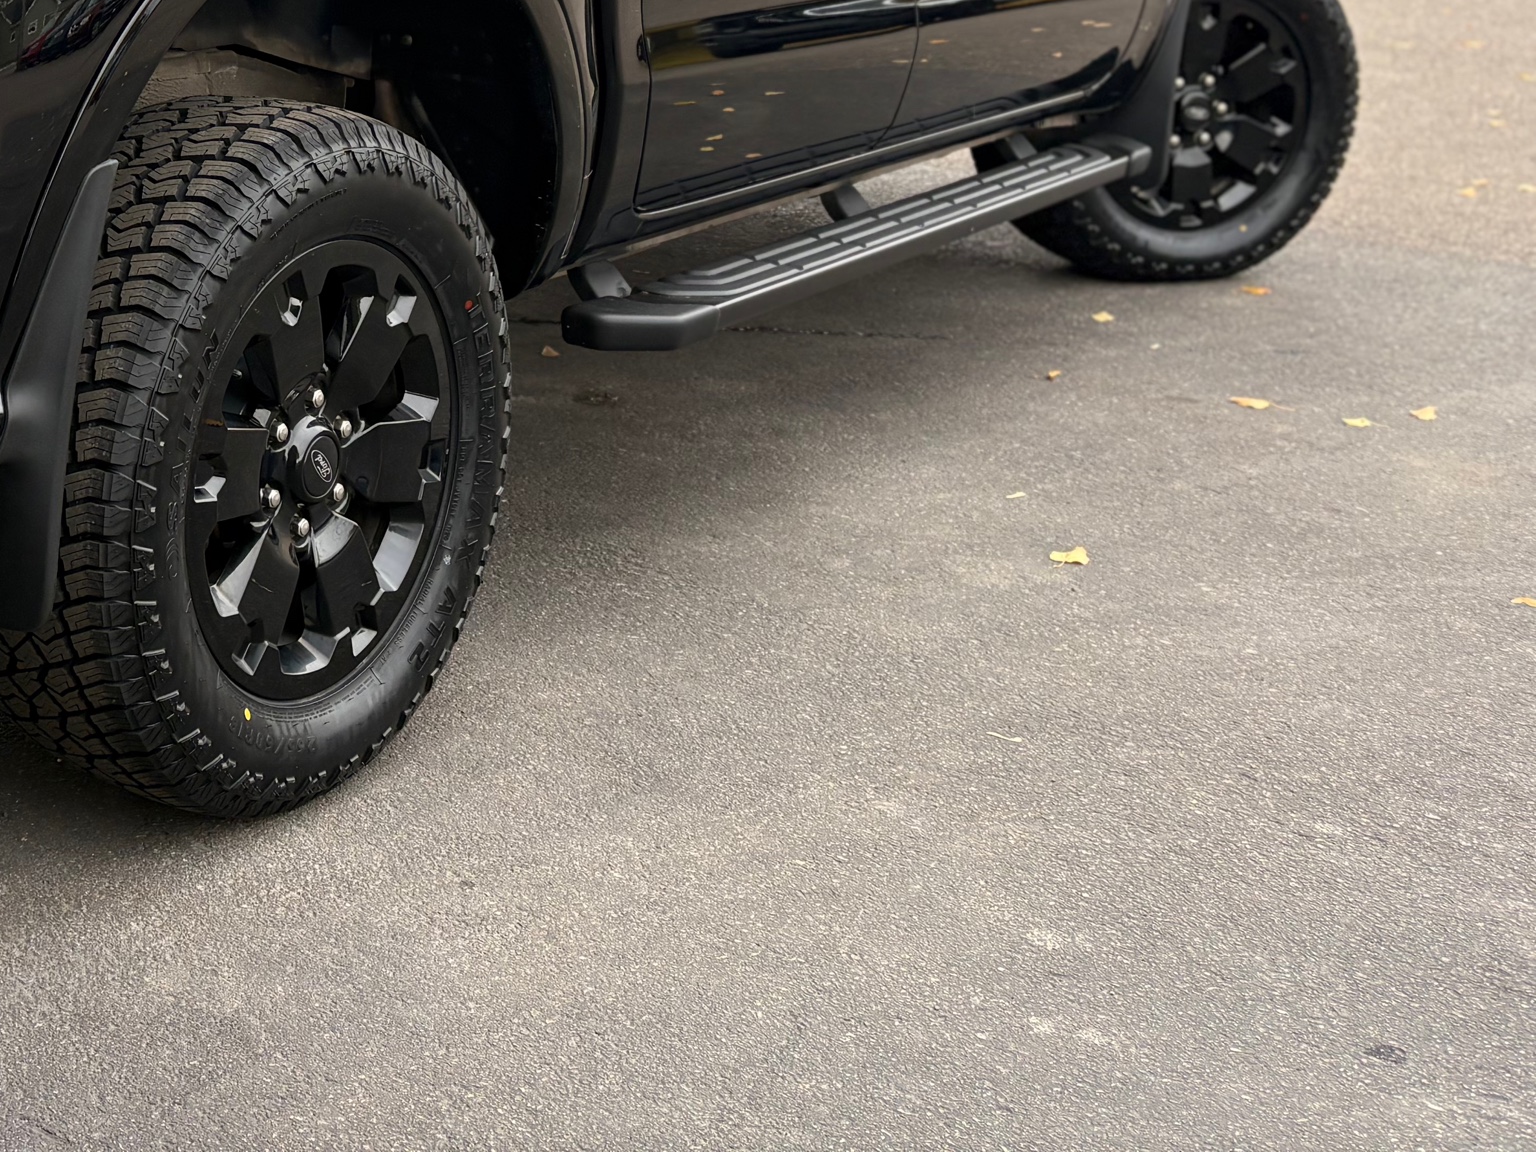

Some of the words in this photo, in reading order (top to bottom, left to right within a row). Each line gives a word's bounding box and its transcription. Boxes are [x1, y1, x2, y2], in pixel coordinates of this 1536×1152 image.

[167, 328, 220, 534] SAILUN
[314, 453, 331, 478] Ford
[454, 291, 497, 570] TERRAMAX
